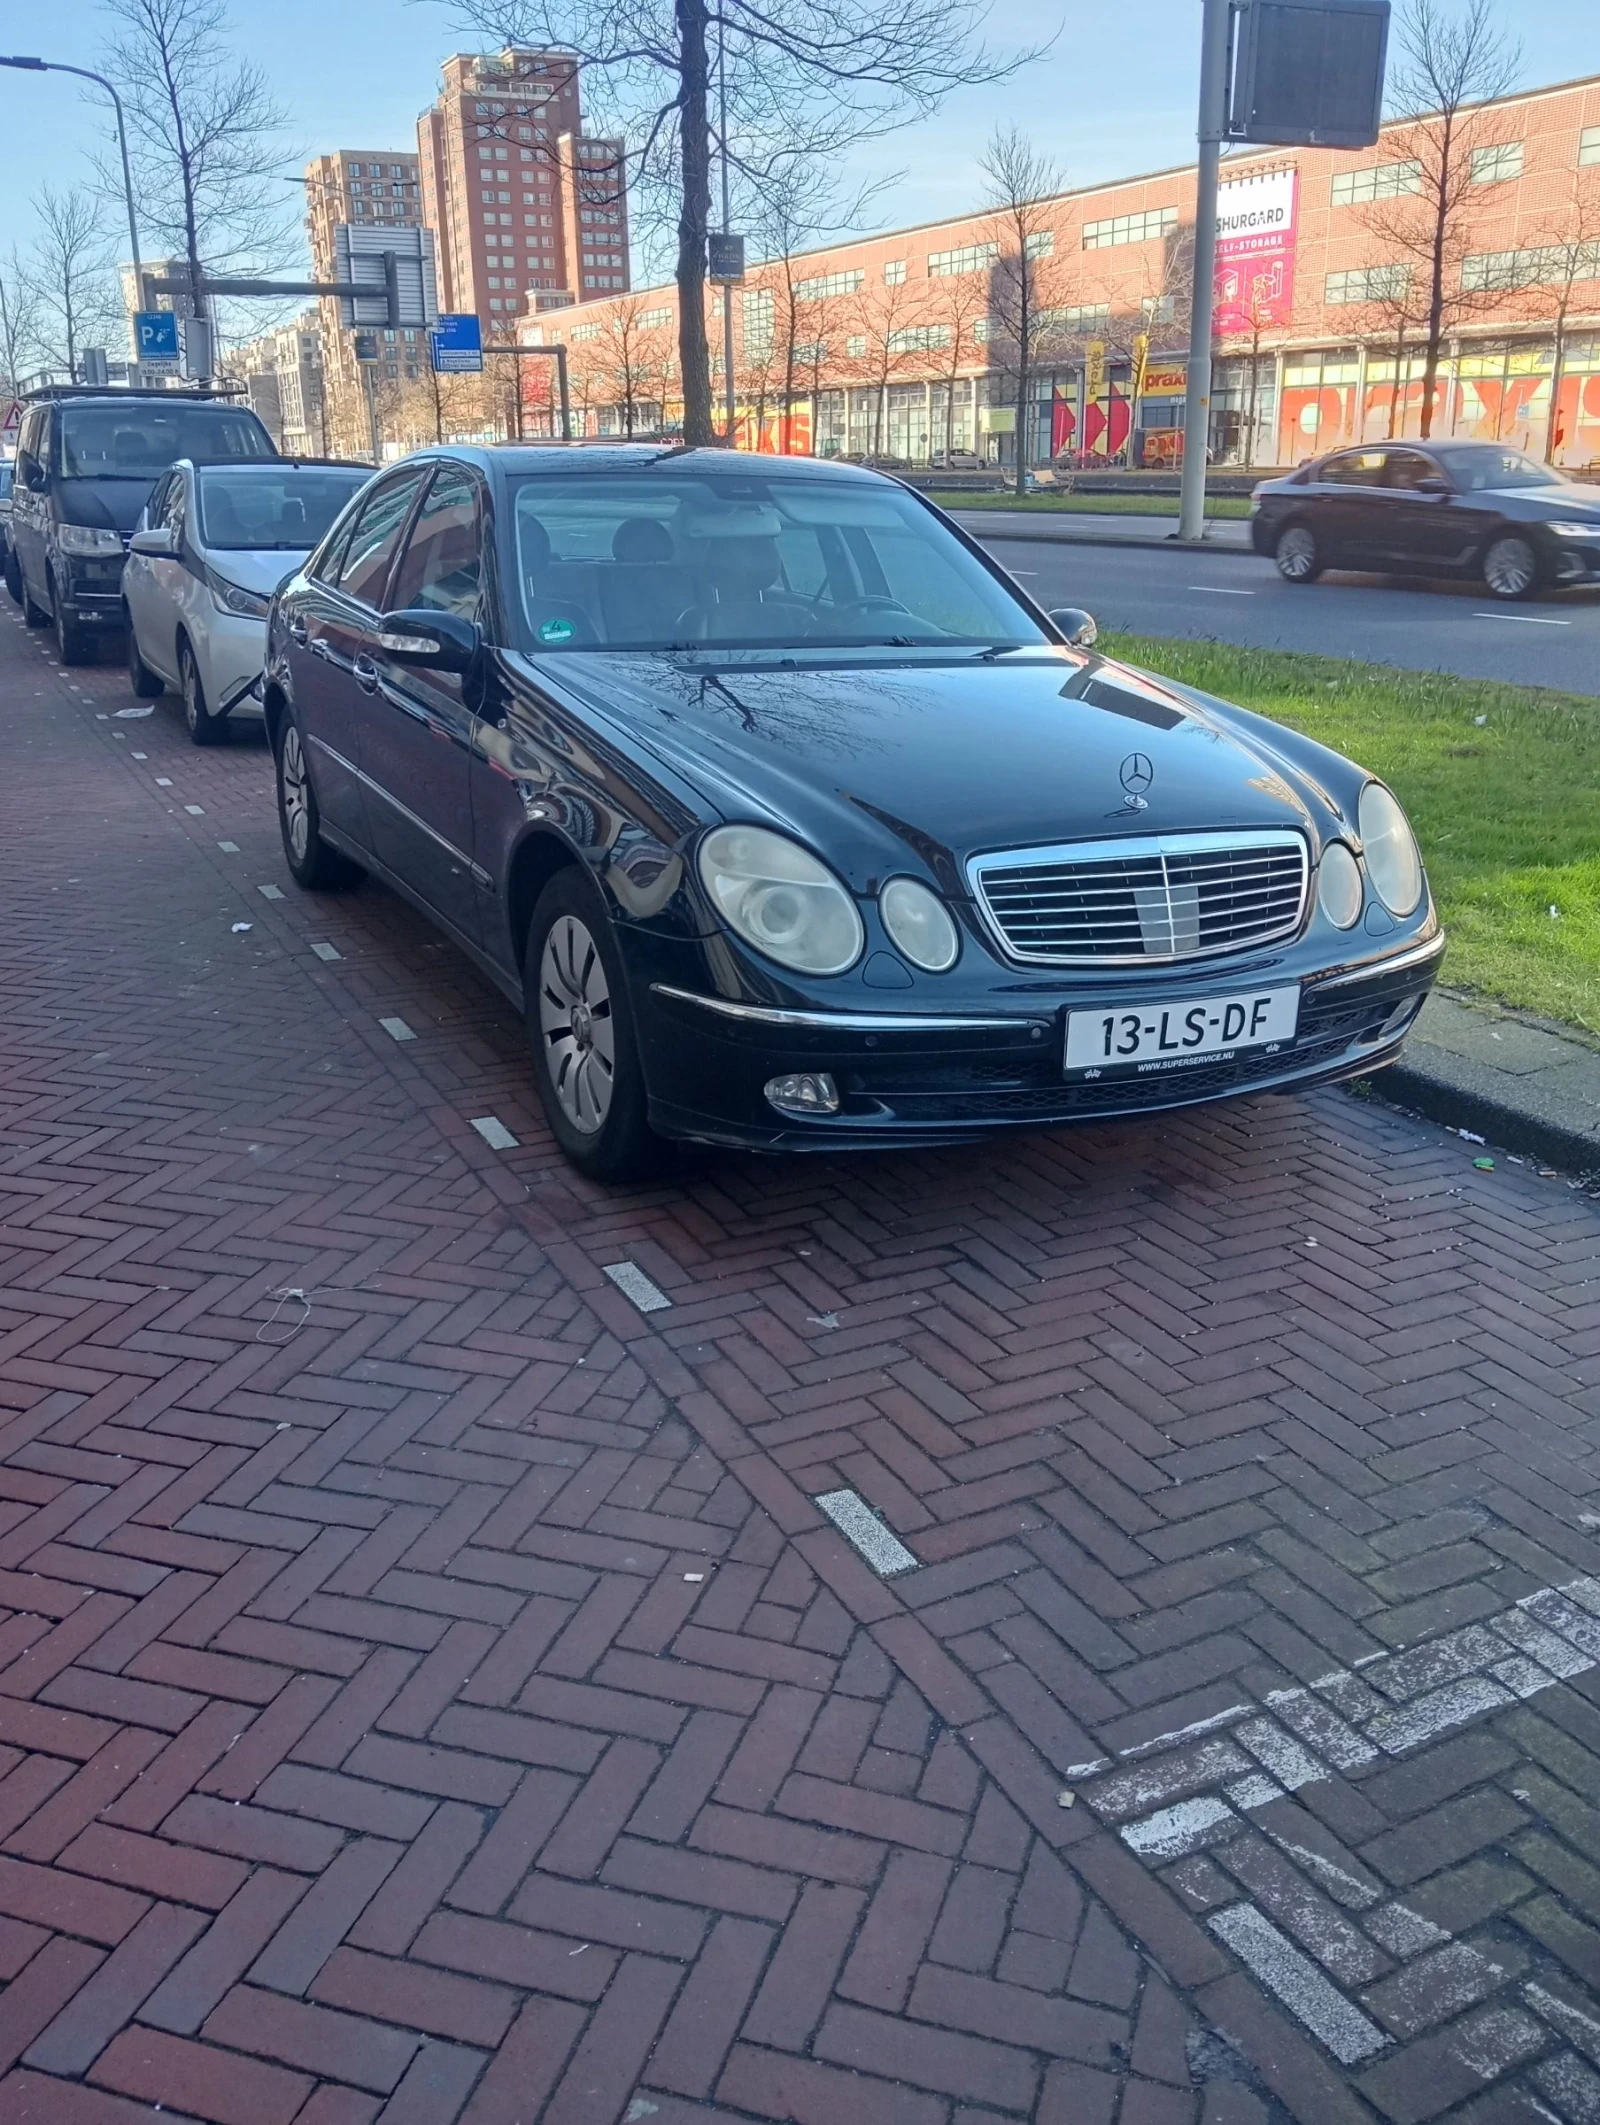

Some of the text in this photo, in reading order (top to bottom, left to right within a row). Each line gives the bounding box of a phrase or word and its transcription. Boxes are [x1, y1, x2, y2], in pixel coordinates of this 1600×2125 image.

[1215, 207, 1284, 233] SHURGARD
[141, 326, 154, 346] P
[1145, 367, 1187, 392] praxi
[551, 620, 562, 631] 4
[1102, 998, 1271, 1056] 13-LS-DF
[1137, 1051, 1235, 1073] WWW.SUPERSERVICE.NU
